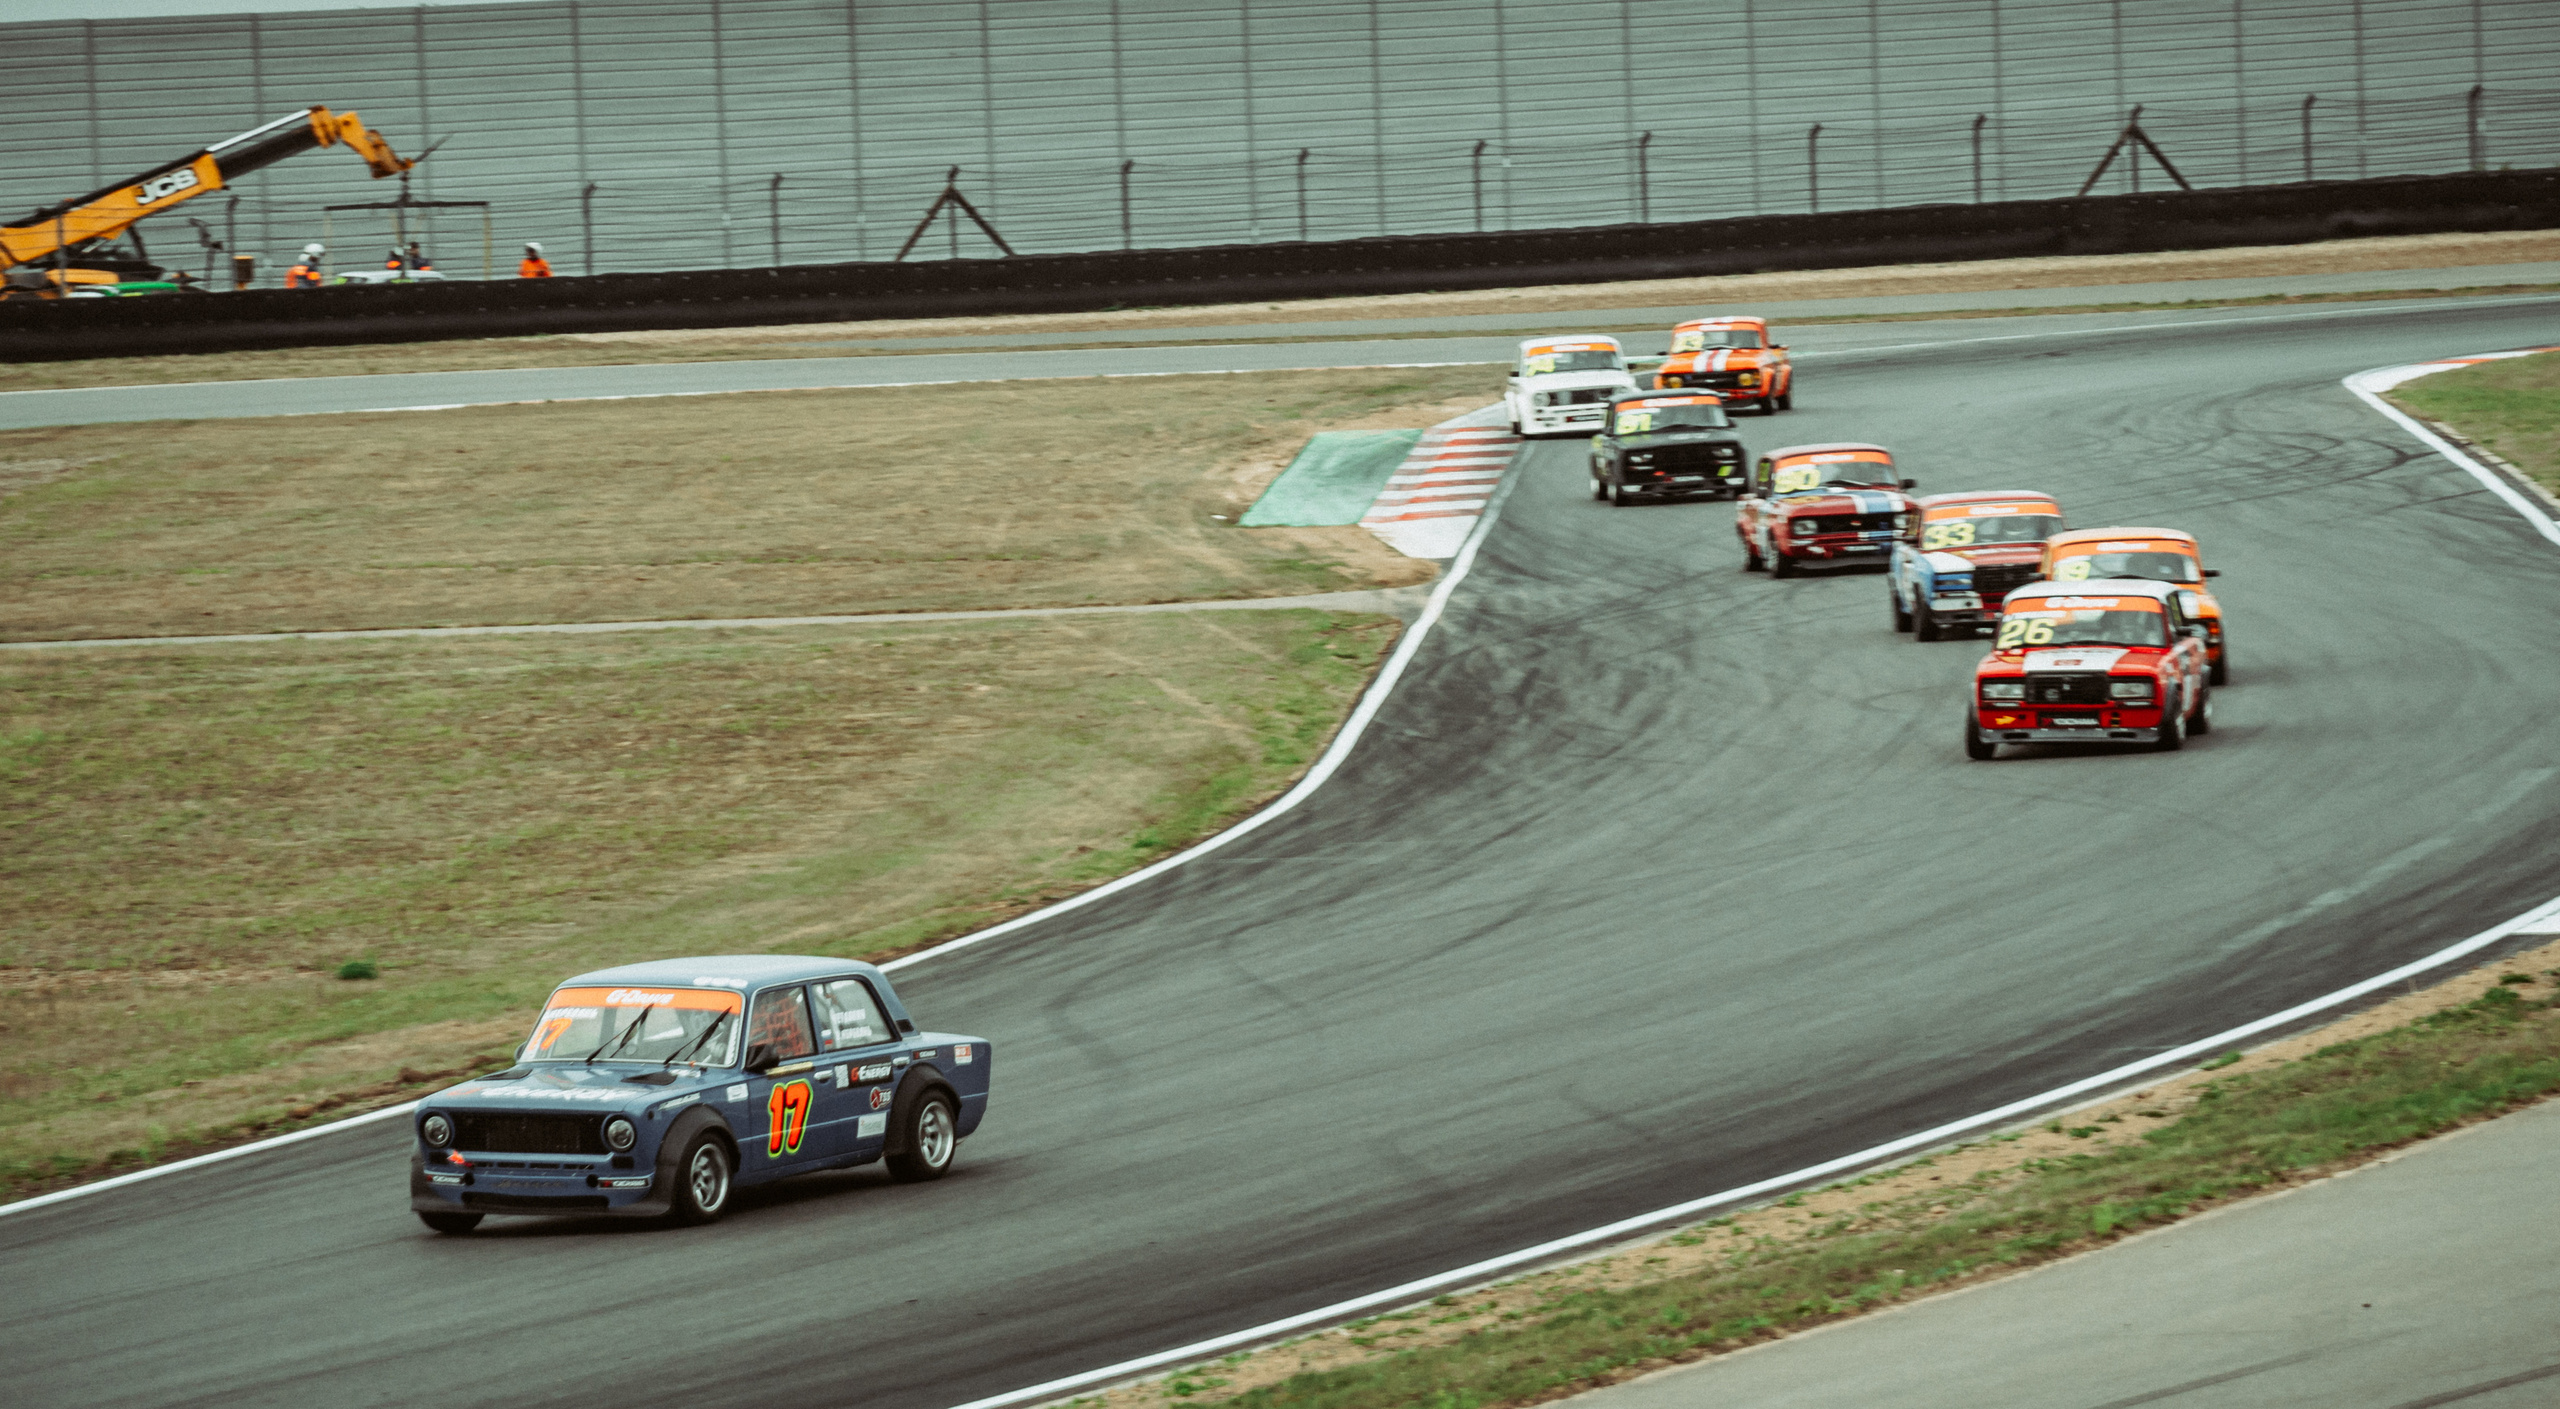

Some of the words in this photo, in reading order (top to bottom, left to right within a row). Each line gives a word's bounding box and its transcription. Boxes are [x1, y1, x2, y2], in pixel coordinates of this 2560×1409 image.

[136, 169, 198, 204] JCB
[1923, 523, 1976, 550] 33
[1997, 618, 2054, 650] 26
[528, 1018, 573, 1051] 17
[768, 1078, 814, 1158] 17
